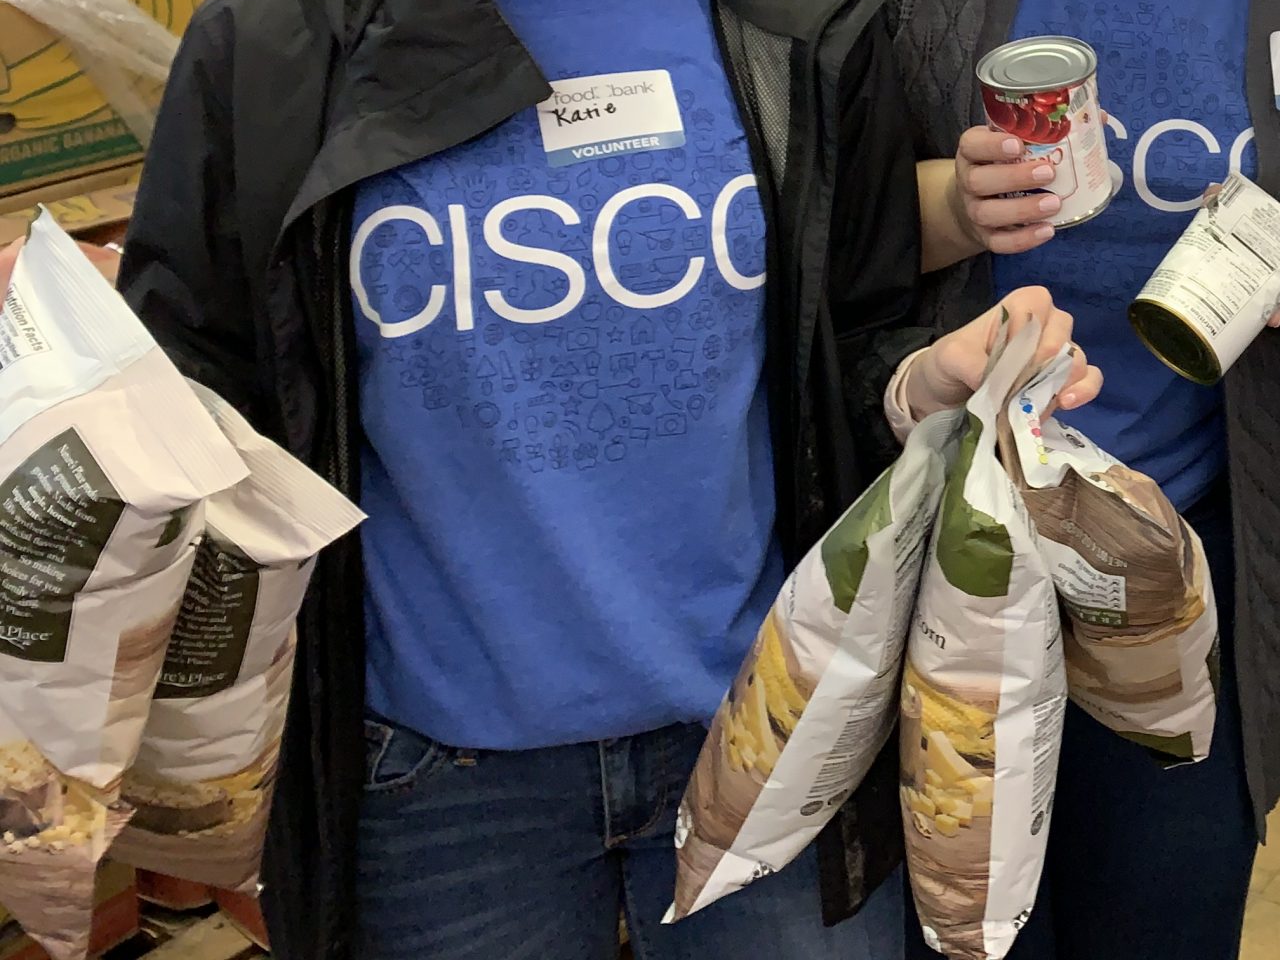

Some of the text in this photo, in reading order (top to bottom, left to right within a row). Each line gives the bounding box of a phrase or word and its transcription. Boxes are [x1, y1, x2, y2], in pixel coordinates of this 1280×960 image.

[554, 81, 655, 105] food bank
[552, 102, 618, 127] Katie
[571, 136, 660, 159] VOLUNTEER
[1189, 306, 1217, 337] Nutrition
[22, 326, 44, 352] Facts
[47, 505, 78, 528] honest
[0, 562, 61, 594] hoices for you
[19, 553, 66, 582] So making
[7, 624, 50, 642] Place
